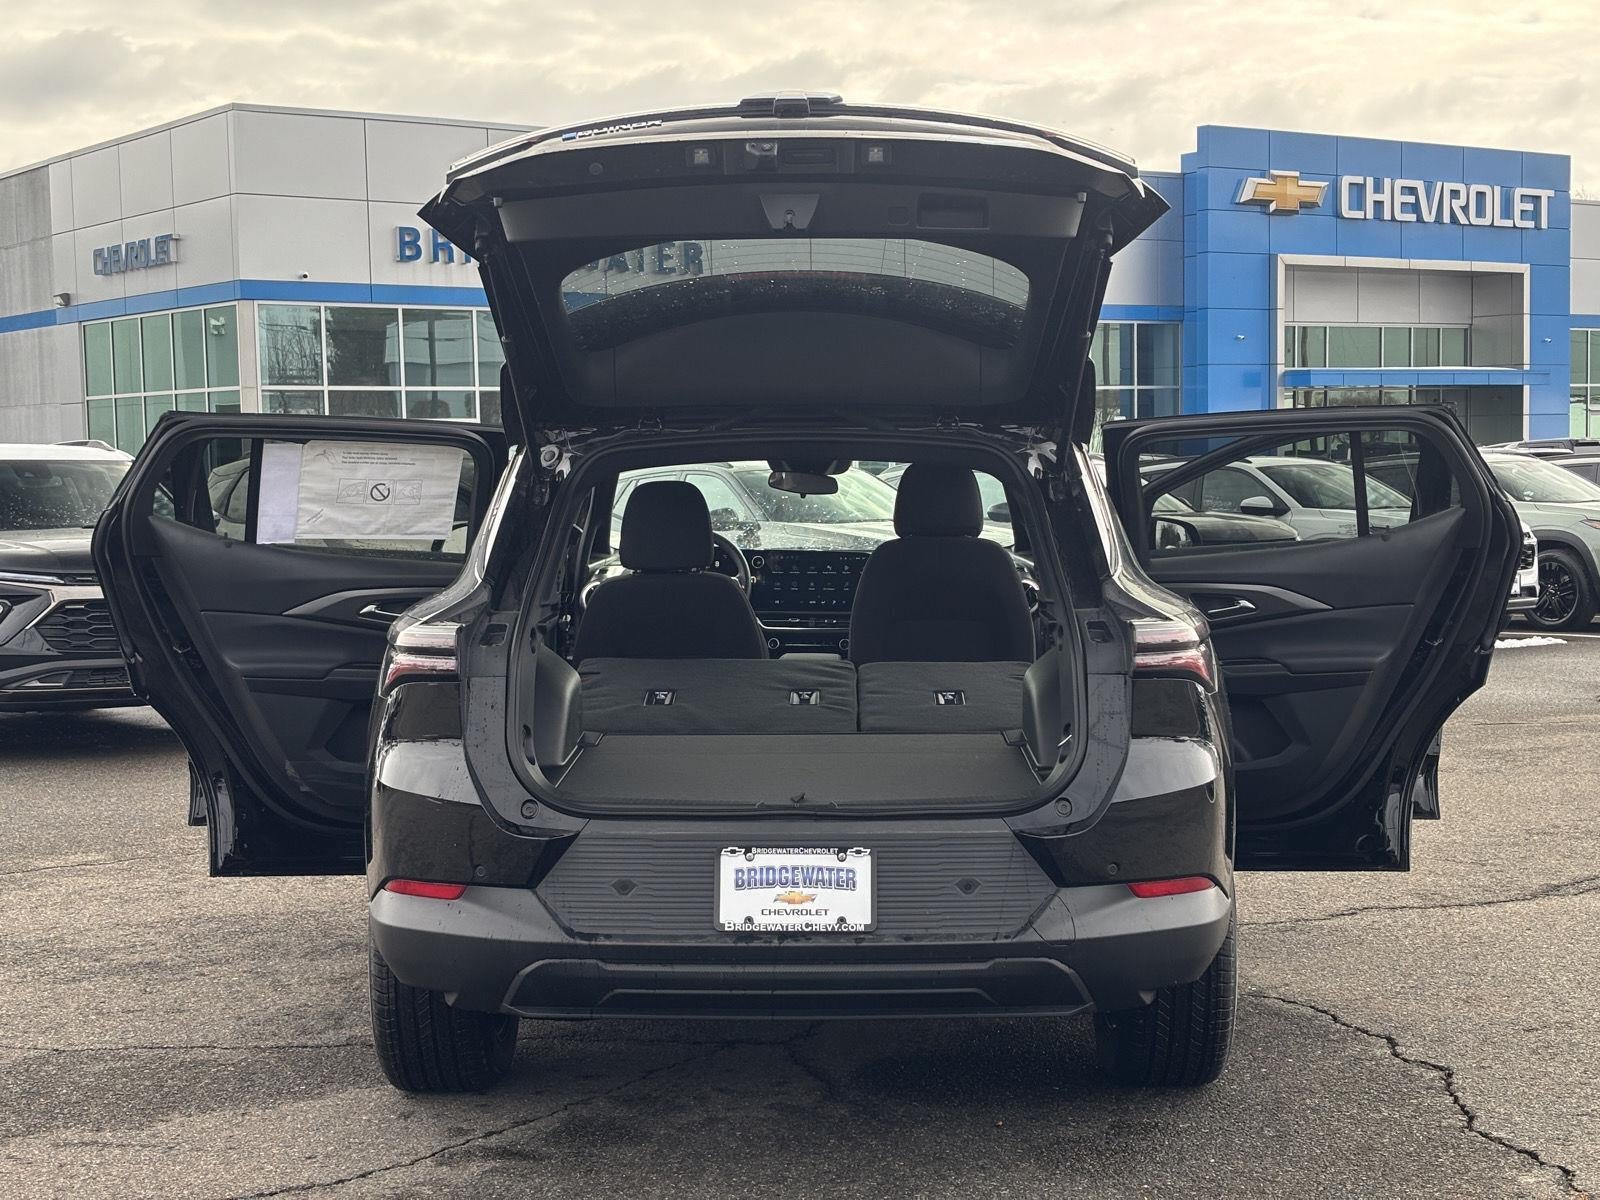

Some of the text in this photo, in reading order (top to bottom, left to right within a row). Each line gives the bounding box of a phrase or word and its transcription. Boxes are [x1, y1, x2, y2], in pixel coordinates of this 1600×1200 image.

[1341, 175, 1555, 229] CHEVROLET
[93, 233, 180, 276] CHEVROLET
[751, 847, 839, 855] BRIDGEWATERCHEVROLET
[735, 865, 857, 891] BRIDGEWATER
[761, 908, 830, 916] CHEVROLET
[724, 920, 865, 932] BRIDGEWATERCHEVY.COM
